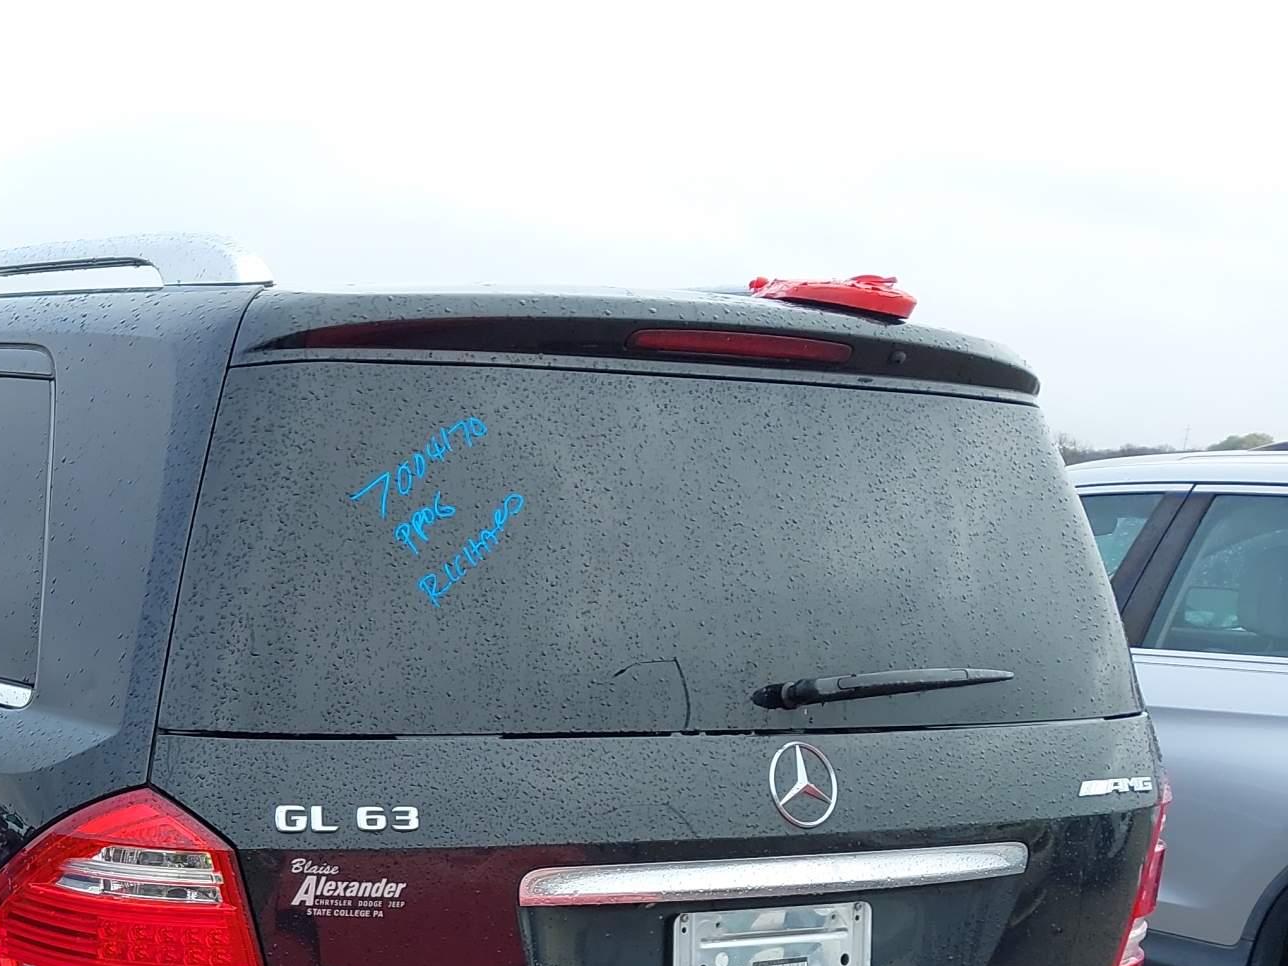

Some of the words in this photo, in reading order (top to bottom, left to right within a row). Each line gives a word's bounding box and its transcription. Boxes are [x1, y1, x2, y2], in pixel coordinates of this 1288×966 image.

[275, 805, 339, 832] GL
[356, 806, 420, 832] 63
[291, 858, 339, 874] Blaise
[291, 875, 407, 906] Alexander
[314, 899, 352, 907] CHRYSLER
[358, 900, 383, 908] DODGE
[307, 908, 332, 916] STATE
[334, 909, 371, 917] COLLEGE
[373, 910, 384, 918] PA
